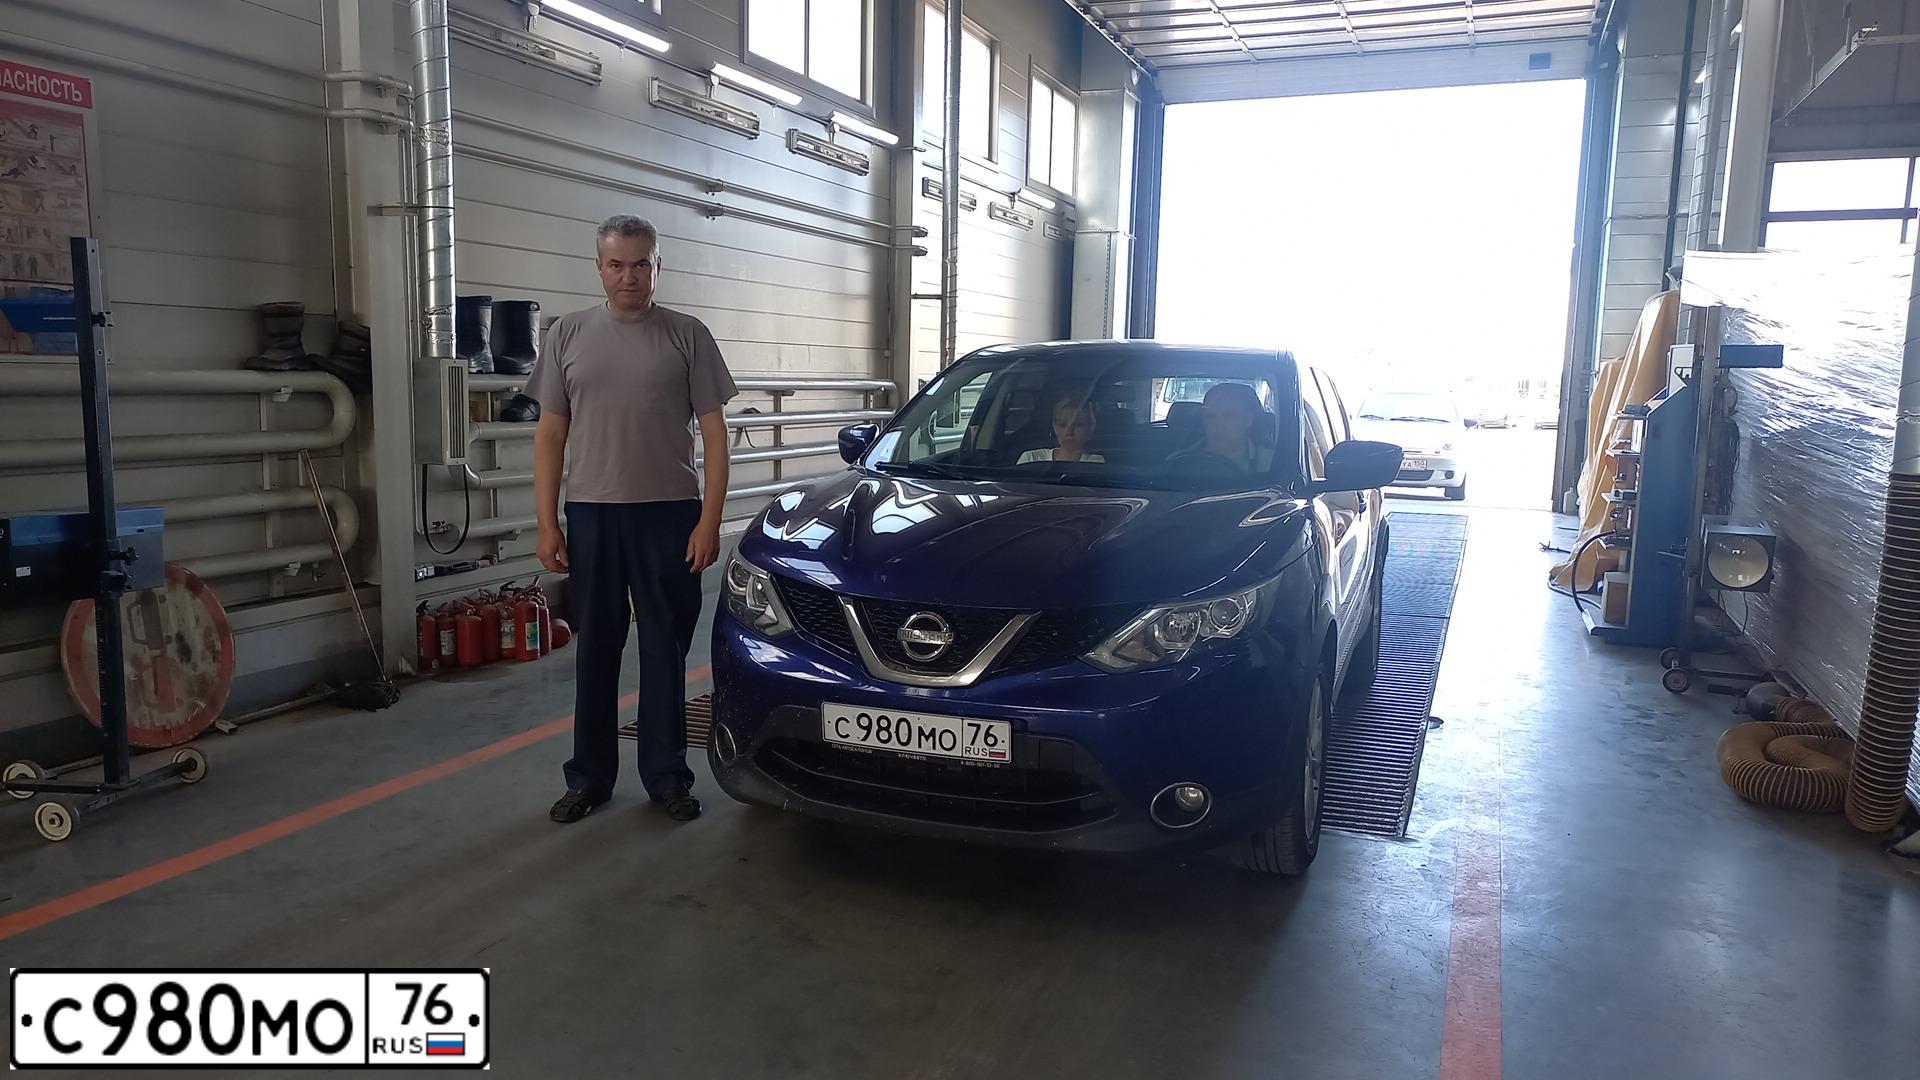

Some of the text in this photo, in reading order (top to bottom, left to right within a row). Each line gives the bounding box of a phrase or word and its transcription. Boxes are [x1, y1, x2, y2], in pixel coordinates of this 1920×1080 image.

[0, 67, 82, 102] АСНОСТЬ
[835, 712, 998, 751] С980МО 76
[965, 746, 988, 757] RUS
